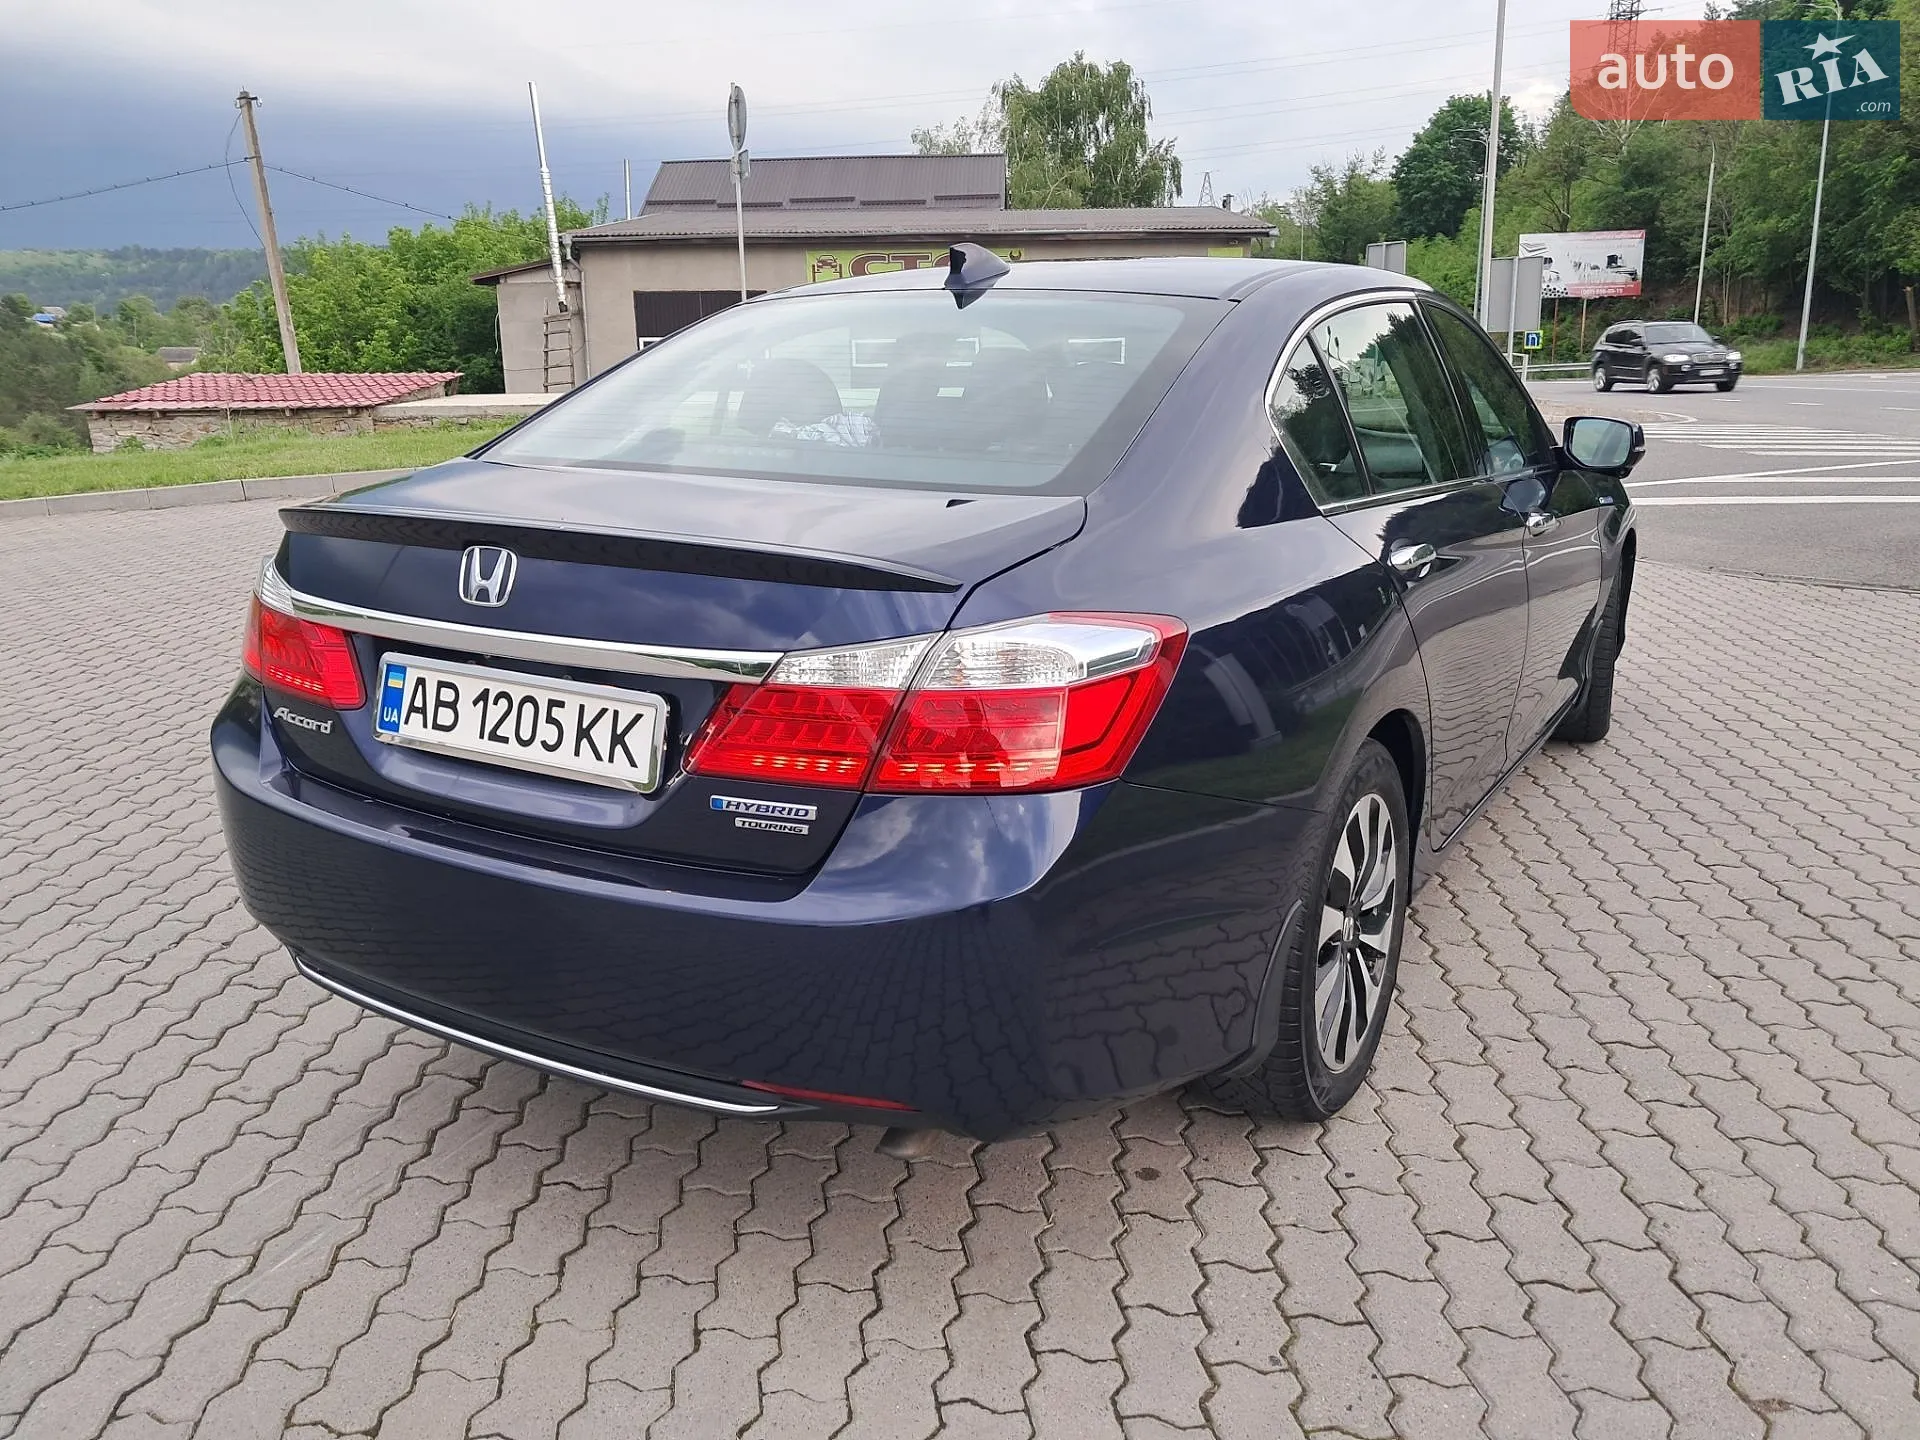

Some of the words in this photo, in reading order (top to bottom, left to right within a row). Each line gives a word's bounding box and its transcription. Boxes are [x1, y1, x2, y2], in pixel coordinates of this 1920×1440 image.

[848, 252, 950, 277] СТ
[272, 706, 334, 735] Accord
[383, 705, 399, 725] UA
[403, 676, 460, 733] AB
[471, 687, 566, 753] 1205
[573, 703, 645, 769] KK
[724, 799, 810, 818] HYBRID
[739, 819, 804, 833] TOURING
